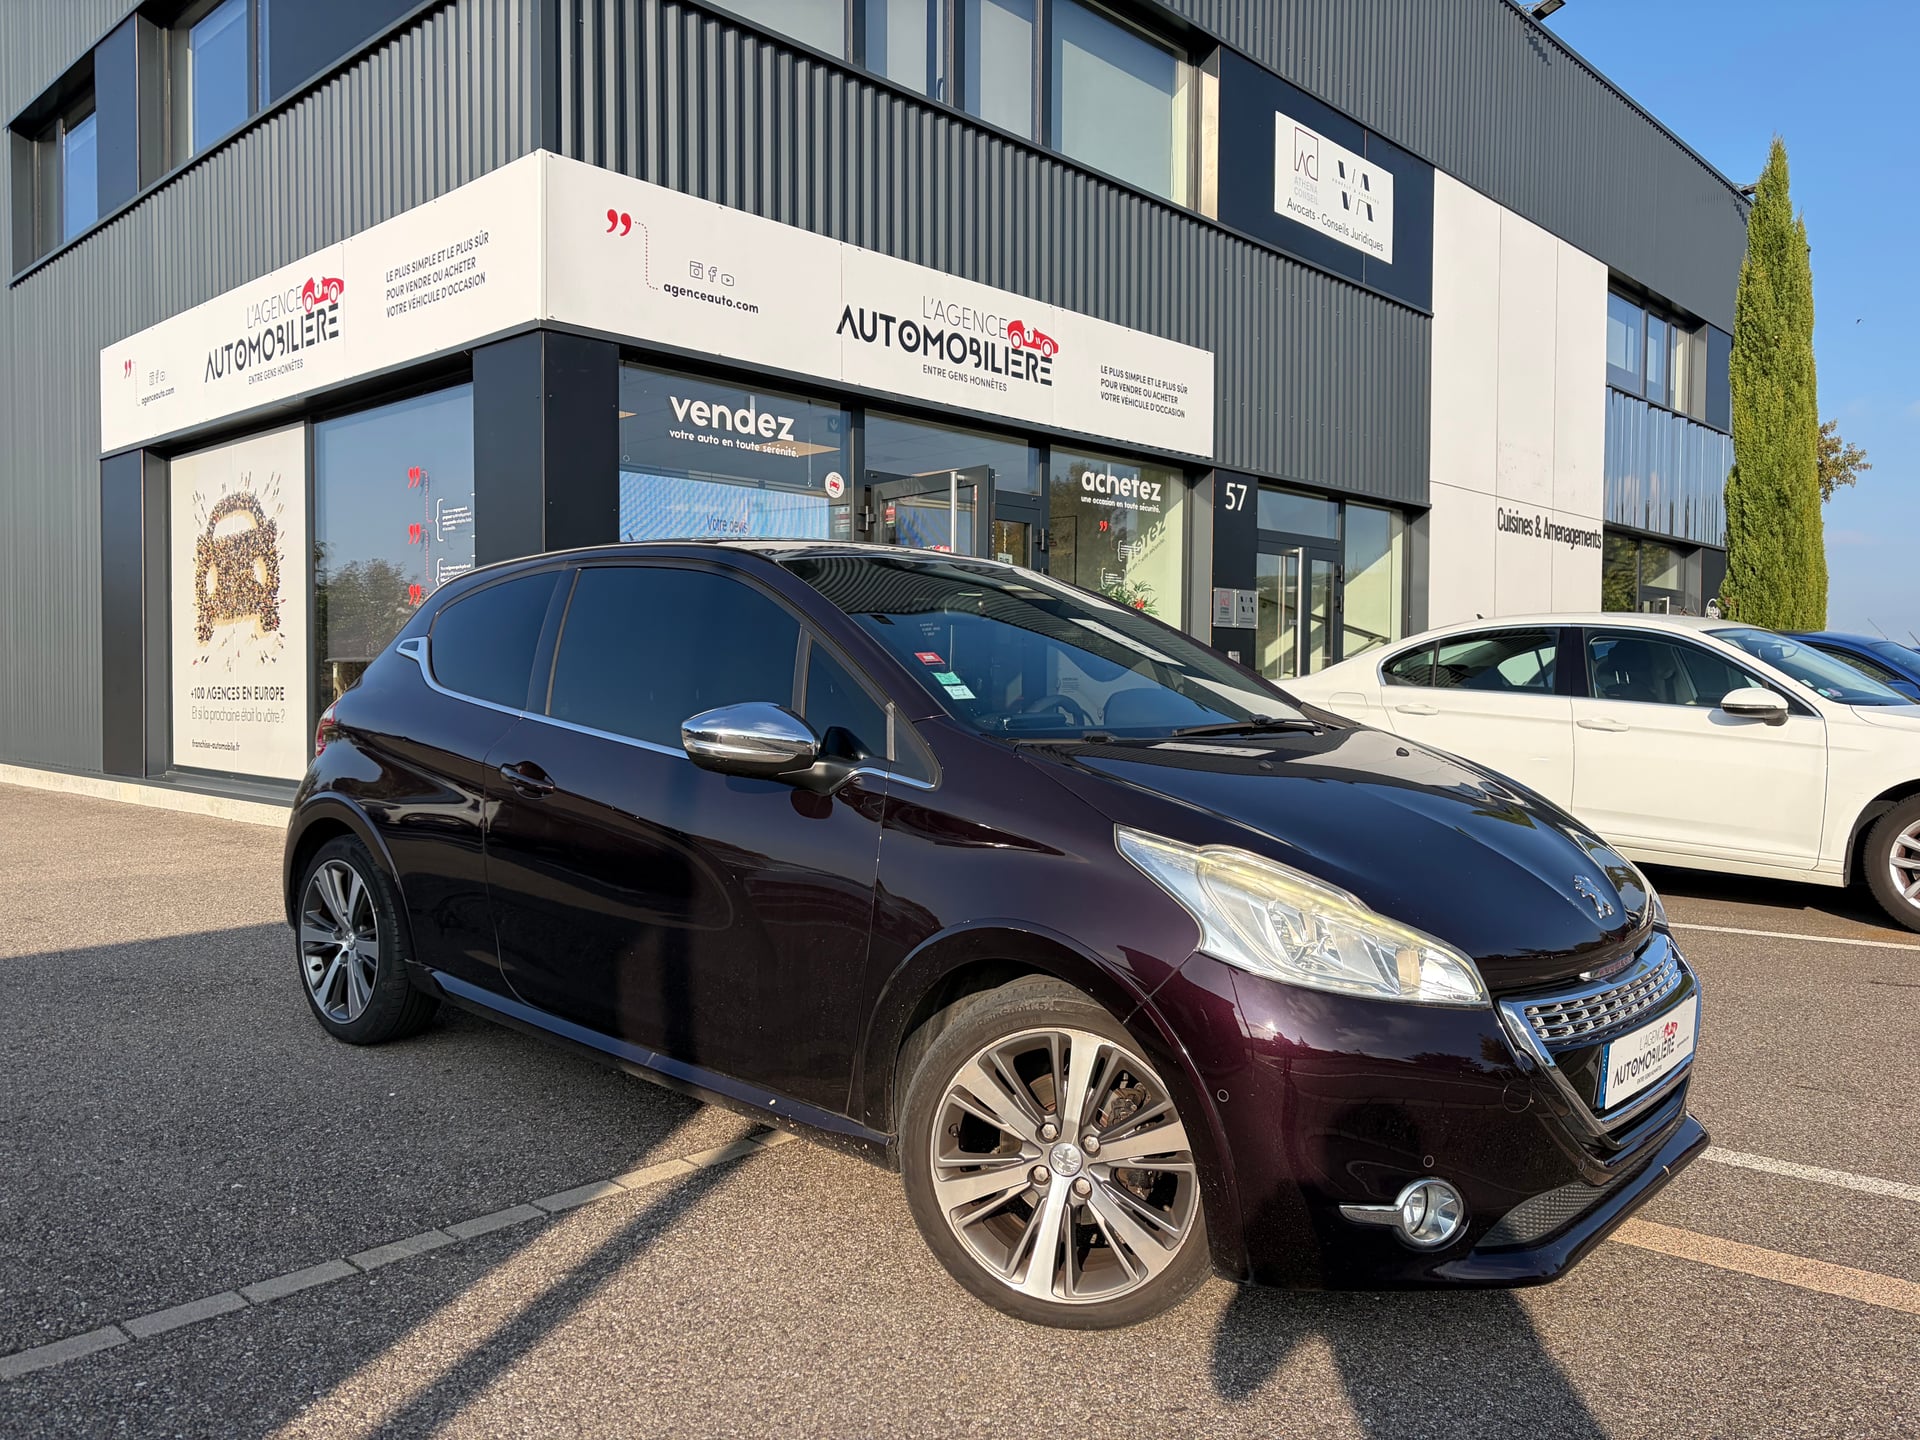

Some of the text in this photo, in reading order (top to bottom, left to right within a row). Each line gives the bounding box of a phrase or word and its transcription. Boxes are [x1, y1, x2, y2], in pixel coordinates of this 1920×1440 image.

[1287, 197, 1316, 220] Avocats
[1322, 213, 1350, 236] Conseils
[1351, 228, 1384, 252] Juridiques
[386, 230, 489, 282] LE PLUS SIMPLE ET LE PLUS SÛR
[386, 256, 476, 300] POUR VENDRE OU ACHETER
[247, 285, 303, 329] L'AGENCE
[386, 272, 486, 318] VOTRE VÉHICULE D'OCCASION
[663, 282, 759, 314] agenceauto.com
[922, 295, 1007, 340] L'AGENCE
[248, 371, 263, 385] ENTRE
[264, 368, 276, 380] GENS
[922, 364, 1008, 392] ENTRE GENS HONNÊTES
[1100, 364, 1188, 394] LE PLUS SIMPLE ET LE PLUS SÛR
[1100, 378, 1178, 404] POUR VENDRE OU ACHETER
[670, 395, 794, 441] vendez
[1100, 391, 1185, 418] VOTRE VÉHICULE D'OCCASION
[669, 430, 799, 458] votre auto en toute sérénité.
[1081, 465, 1162, 502] achetez
[1225, 482, 1248, 512] 57
[1080, 496, 1092, 504] une
[1092, 498, 1116, 506] occasion
[1124, 501, 1138, 510] toute
[706, 514, 728, 532] Votre
[1498, 507, 1602, 550] Cuisines & Amenagements
[191, 686, 284, 701] +100 AGENCES EN EUROPE
